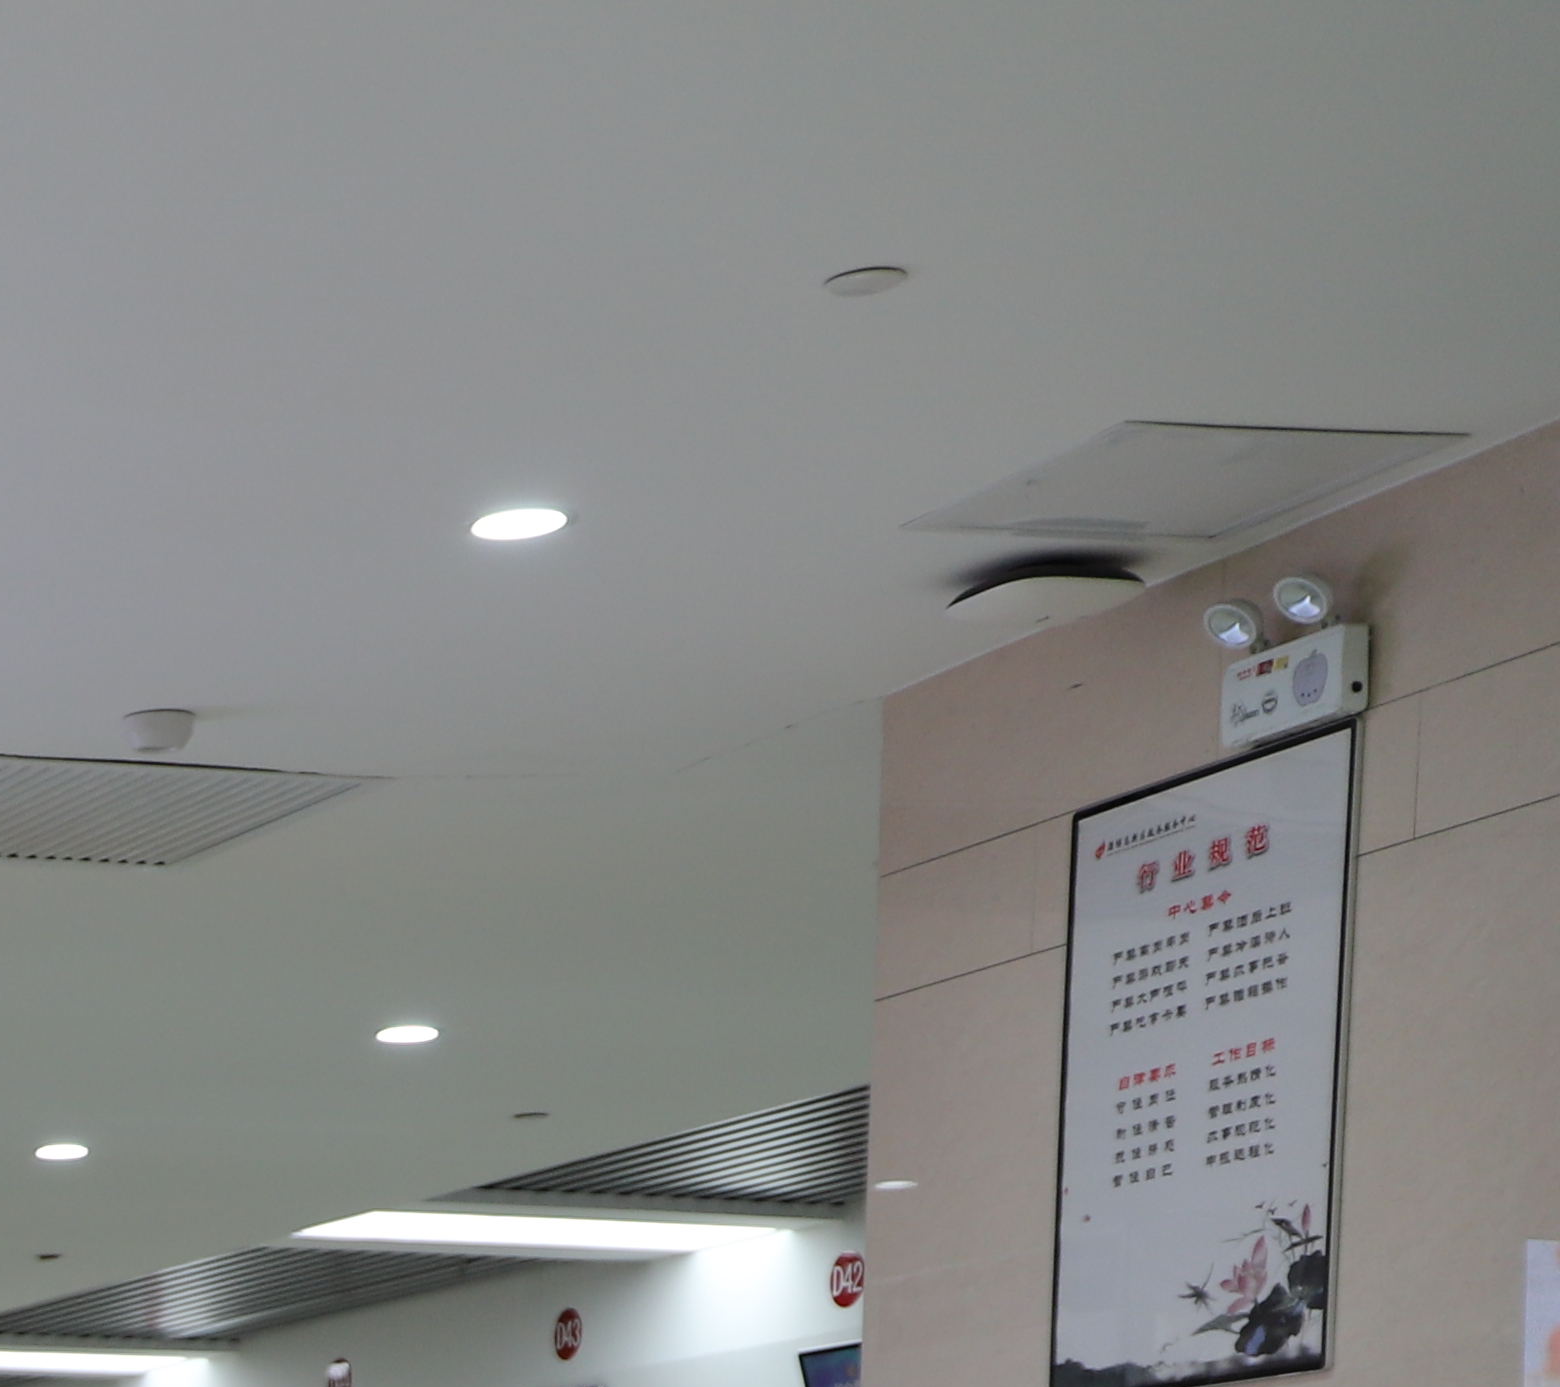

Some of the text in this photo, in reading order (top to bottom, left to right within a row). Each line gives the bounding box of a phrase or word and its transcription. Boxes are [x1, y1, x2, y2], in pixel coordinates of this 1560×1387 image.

[1138, 825, 1268, 892] 行业规范
[1167, 890, 1231, 916] 中心禁令
[1212, 1037, 1274, 1065] 工作目标
[833, 1261, 864, 1296] D42
[556, 1319, 581, 1350] D43
